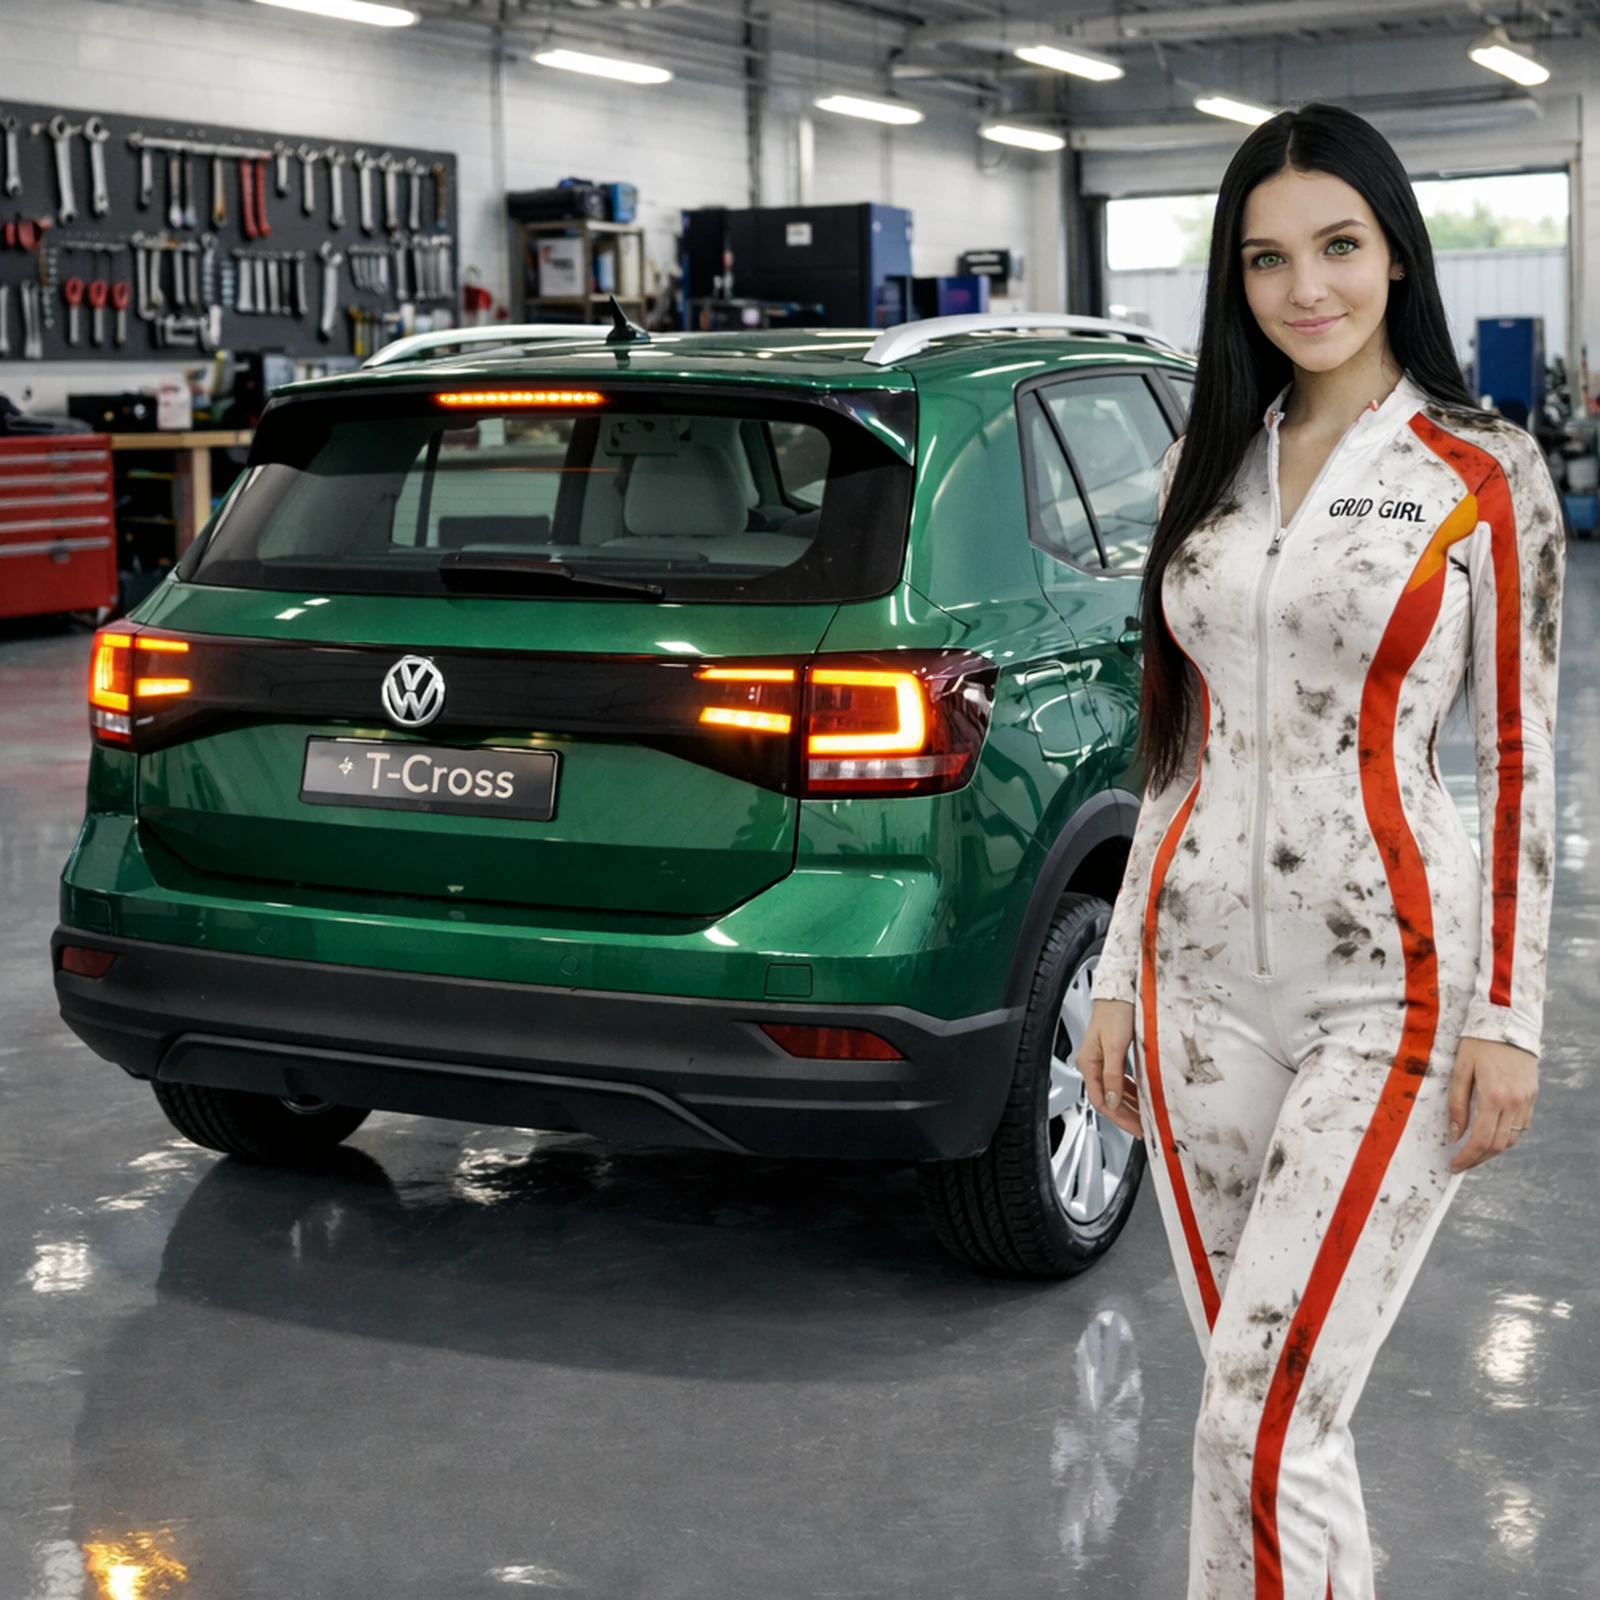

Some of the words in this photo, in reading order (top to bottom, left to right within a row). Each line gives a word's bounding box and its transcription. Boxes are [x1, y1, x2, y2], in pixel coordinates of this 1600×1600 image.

[1329, 498, 1374, 517] GRID
[1379, 500, 1426, 522] GIRL
[383, 655, 445, 727] VW
[366, 752, 514, 798] T-Cross
